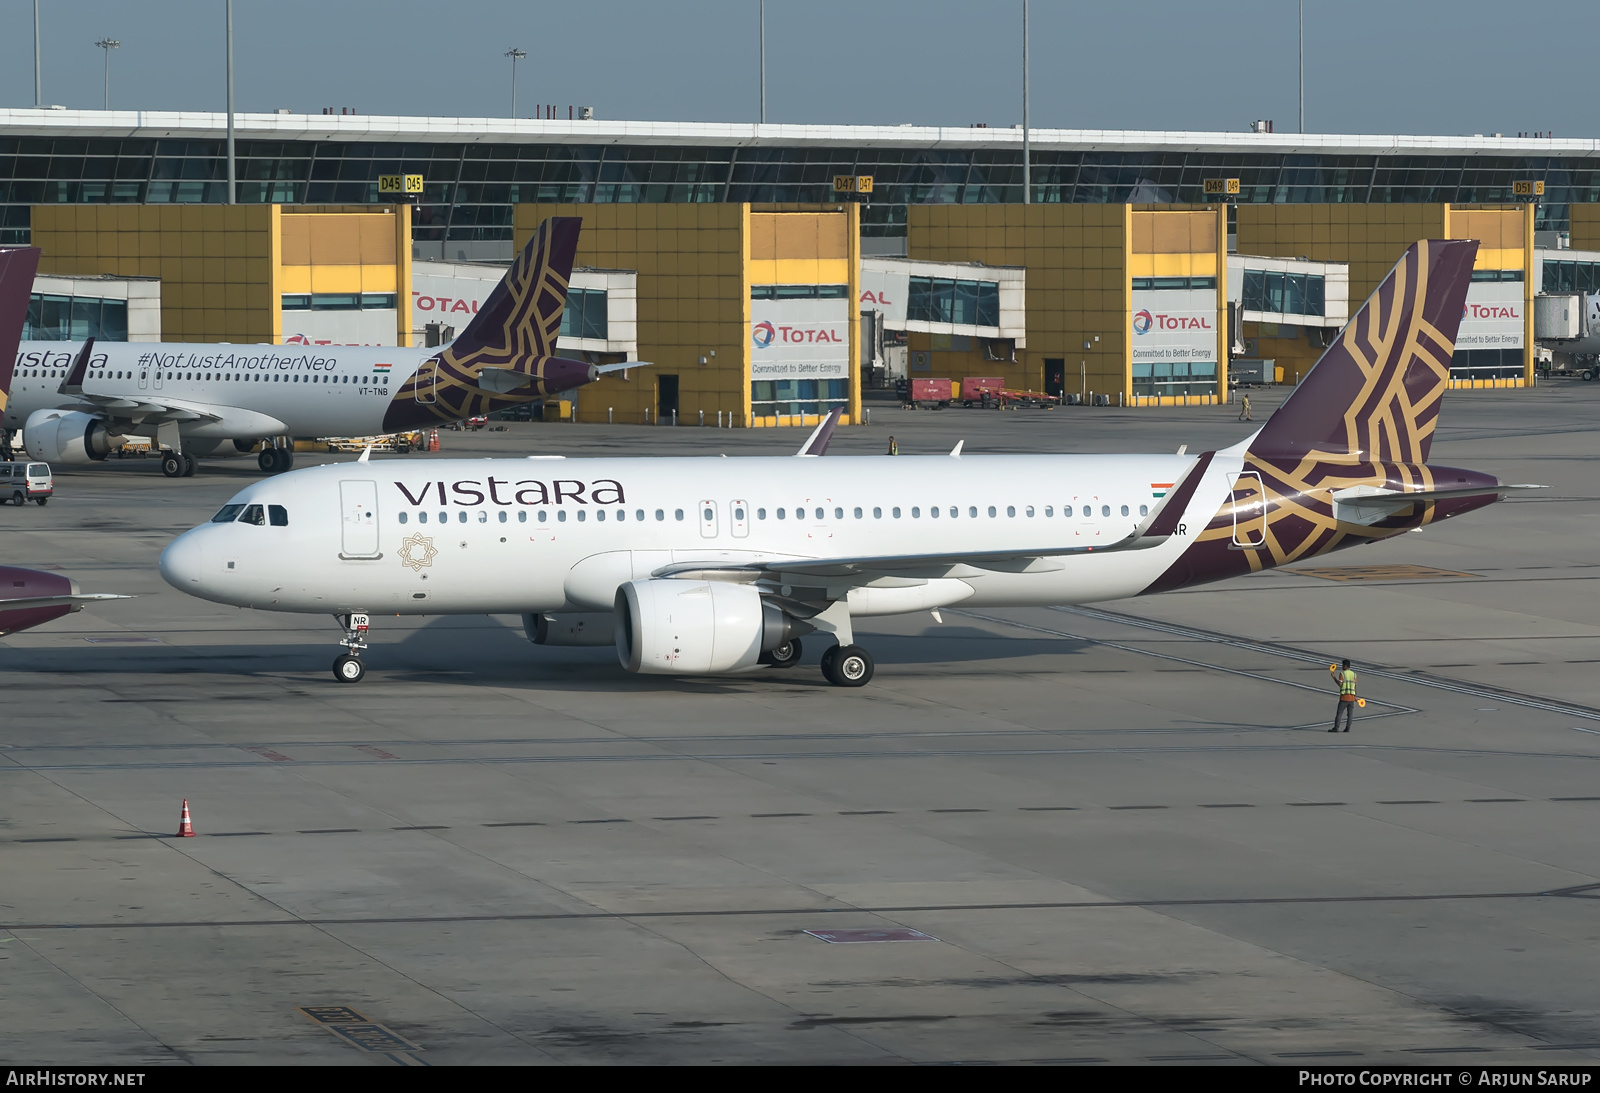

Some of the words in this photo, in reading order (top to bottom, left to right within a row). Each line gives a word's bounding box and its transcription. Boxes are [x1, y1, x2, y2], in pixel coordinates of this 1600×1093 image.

[382, 177, 400, 190] D45
[407, 177, 420, 190] D45
[836, 178, 854, 190] D47
[859, 178, 871, 190] D47
[1206, 180, 1223, 192] D49
[1228, 180, 1238, 192] D49
[1516, 182, 1531, 193] D51
[412, 291, 480, 314] OTAL
[1471, 304, 1519, 319] TOTAL
[1155, 314, 1211, 330] TOTAL
[778, 326, 842, 343] TOTAL
[1485, 335, 1500, 343] Better
[1501, 335, 1519, 344] Energy
[1133, 349, 1164, 358] Committed
[1165, 349, 1171, 357] to
[1172, 349, 1190, 357] Better
[1192, 349, 1211, 358] Energy
[138, 352, 337, 371] #NotJustAnotherNeo
[752, 364, 788, 374] Committed
[789, 364, 796, 373] to
[798, 363, 817, 373] Better
[820, 363, 841, 374] Energy
[358, 387, 388, 396] VT-TNB
[353, 616, 367, 625] NR
